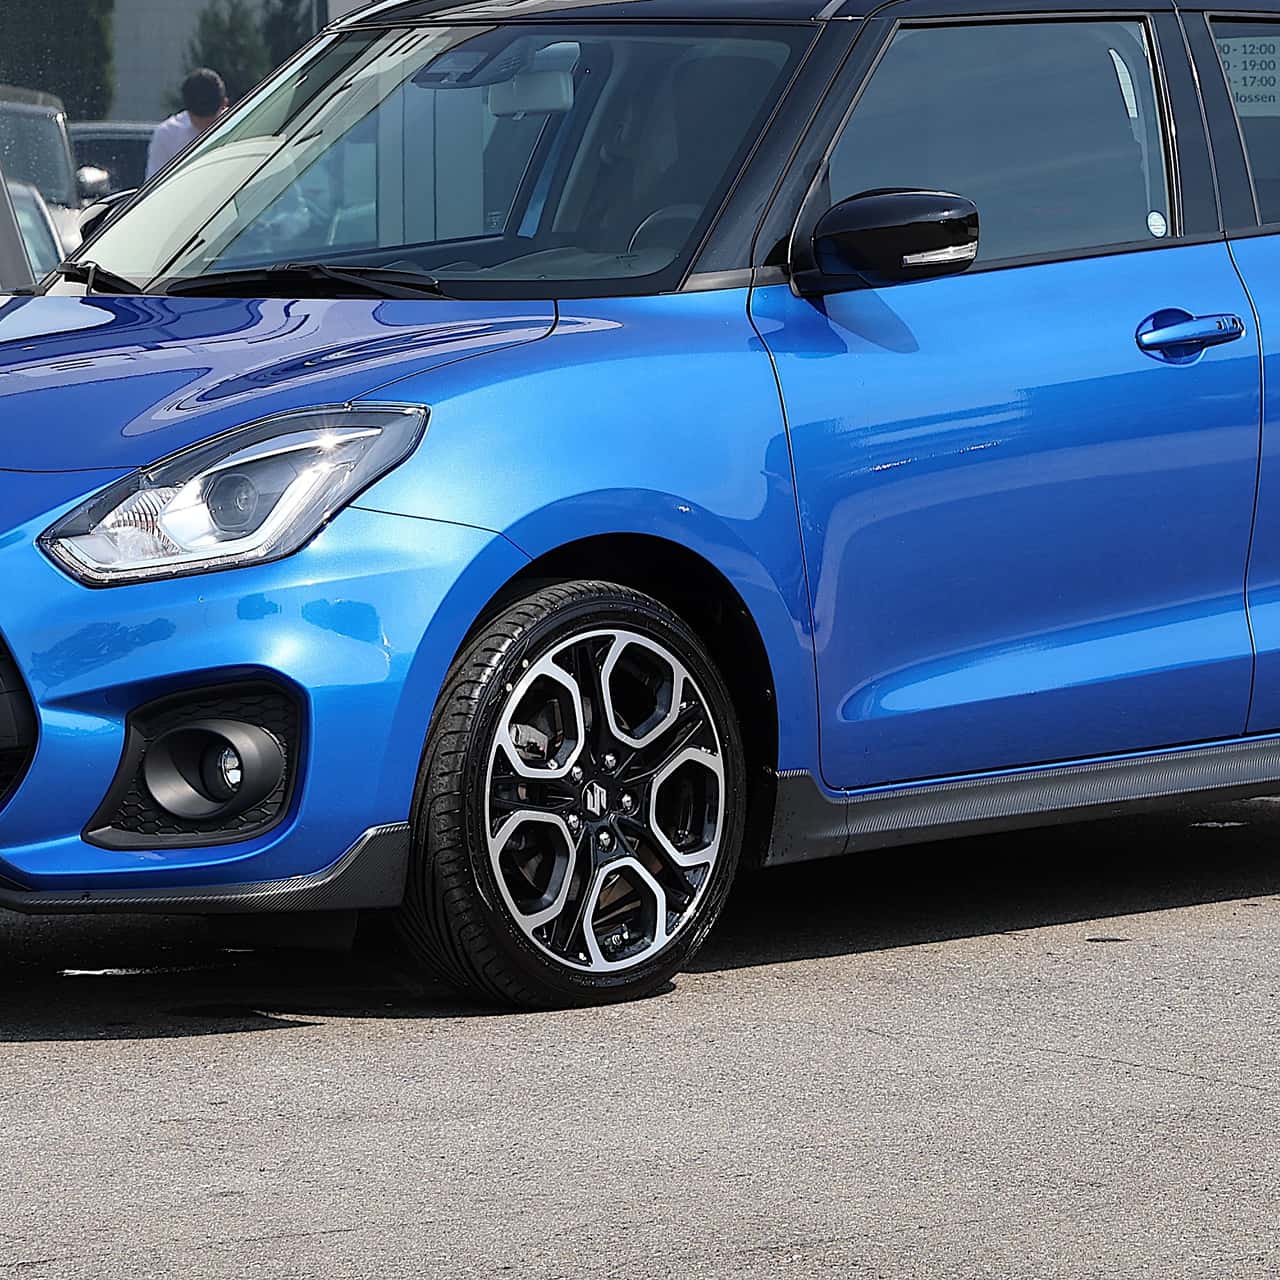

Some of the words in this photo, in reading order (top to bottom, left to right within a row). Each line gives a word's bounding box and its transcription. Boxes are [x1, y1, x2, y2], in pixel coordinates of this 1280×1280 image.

[1242, 44, 1276, 55] 12:00
[1242, 60, 1276, 71] 19:00
[1242, 76, 1276, 87] 17:00
[1235, 91, 1276, 103] lossen
